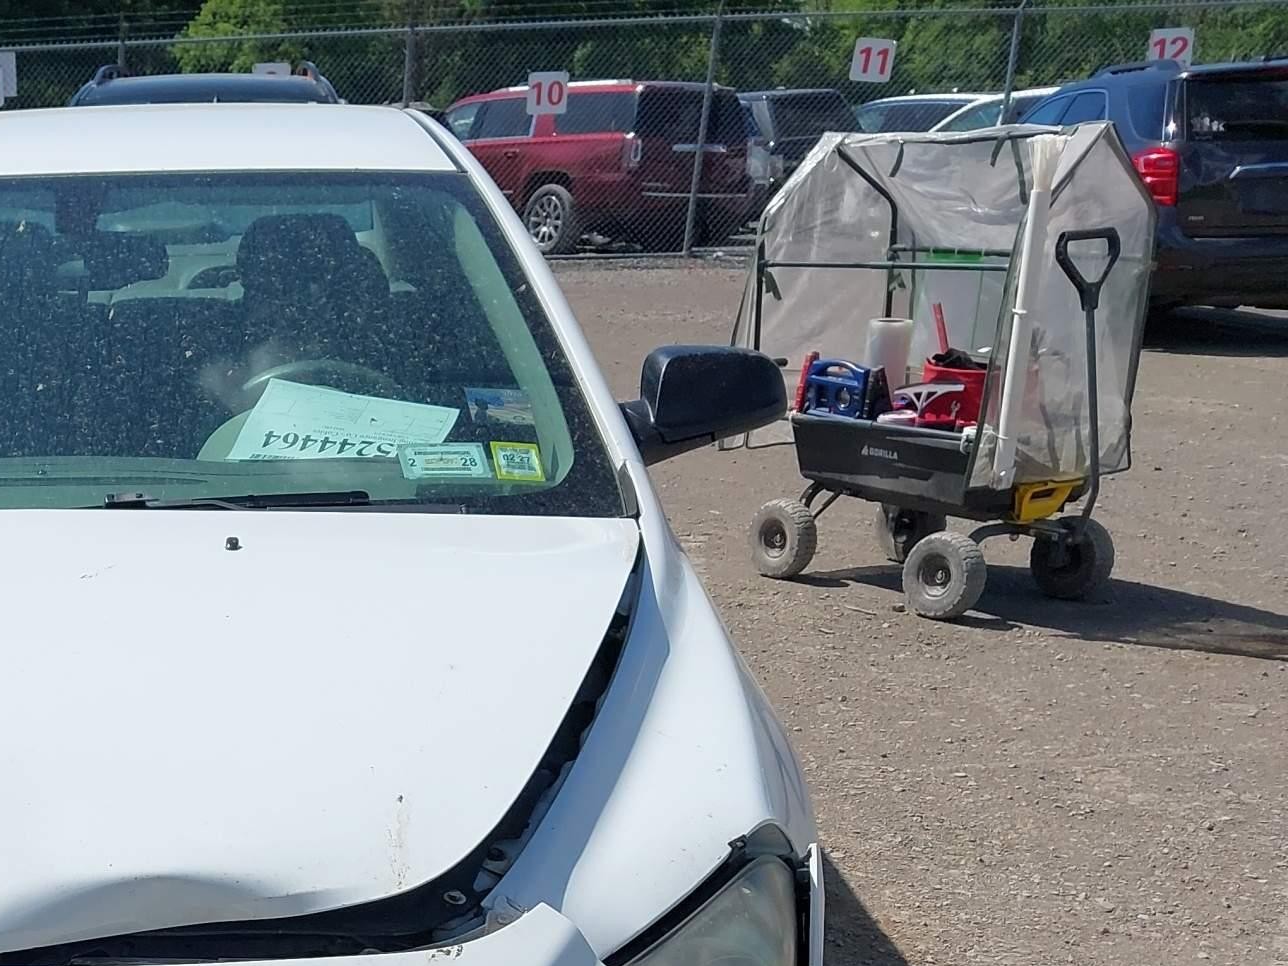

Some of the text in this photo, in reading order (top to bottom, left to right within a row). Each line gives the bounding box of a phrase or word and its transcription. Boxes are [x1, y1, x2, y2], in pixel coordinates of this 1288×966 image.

[859, 46, 890, 74] 11
[1153, 37, 1190, 60] 12
[534, 82, 565, 106] 10
[459, 456, 478, 468] 28
